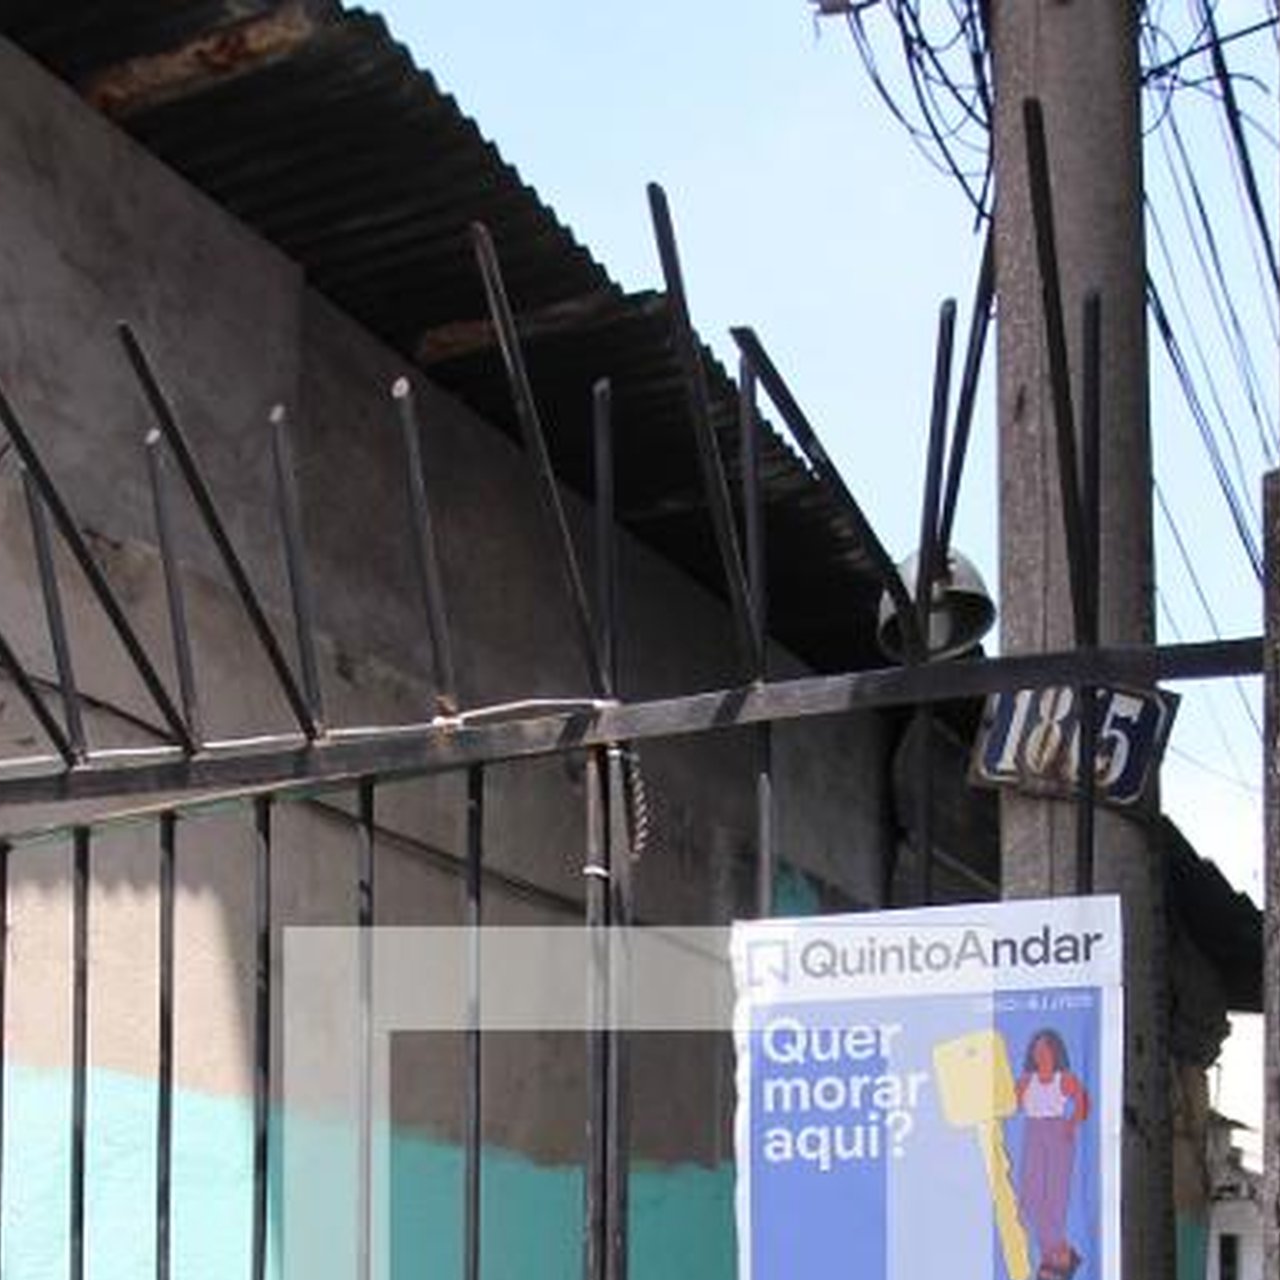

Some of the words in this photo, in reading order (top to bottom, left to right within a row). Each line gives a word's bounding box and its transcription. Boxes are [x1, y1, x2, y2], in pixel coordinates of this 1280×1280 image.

[800, 926, 1103, 980] QuintoAndar
[762, 1018, 903, 1064] Quer
[763, 1072, 928, 1113] morar
[764, 1112, 914, 1171] aqui?
